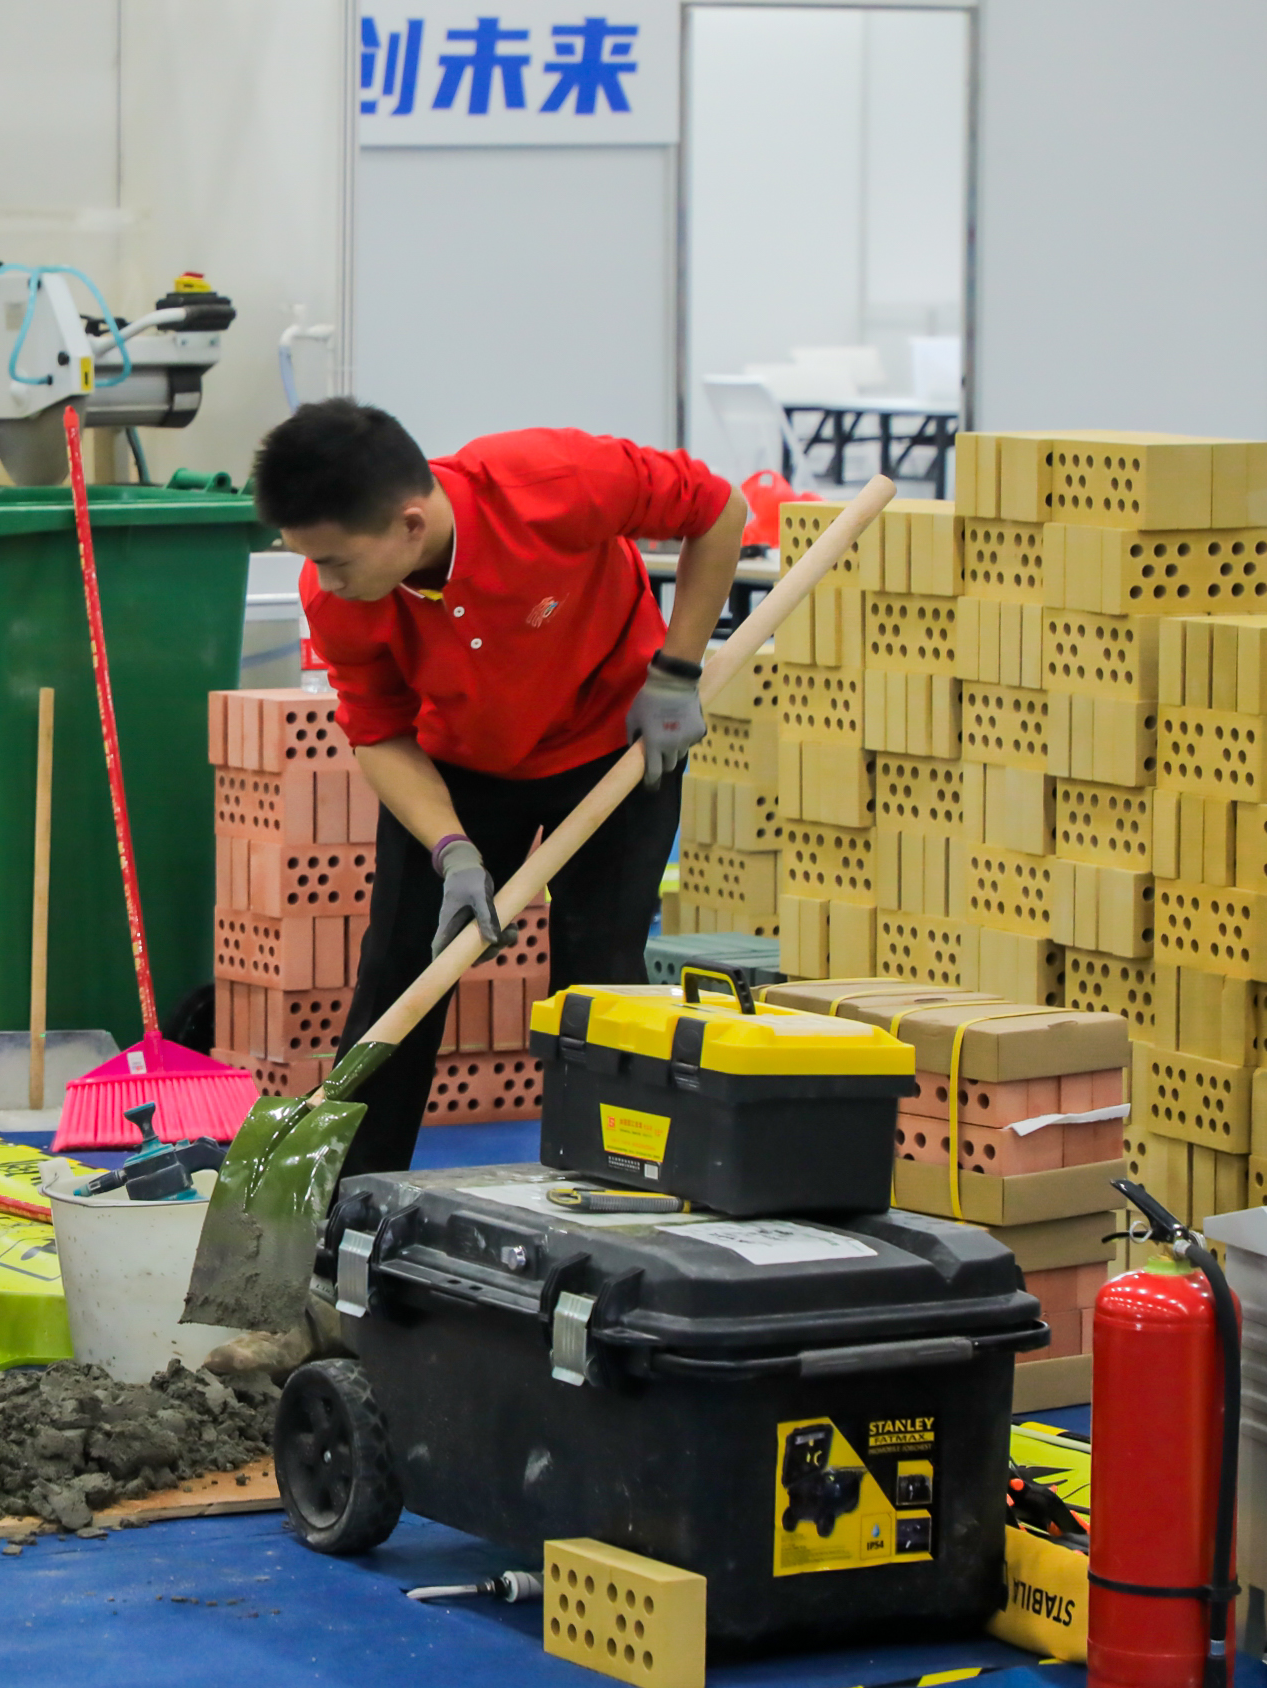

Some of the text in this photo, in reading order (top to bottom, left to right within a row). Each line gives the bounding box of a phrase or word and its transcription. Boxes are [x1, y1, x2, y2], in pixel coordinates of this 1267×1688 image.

[360, 17, 640, 116] 创未来
[869, 1417, 935, 1435] STANLEY
[874, 1433, 926, 1445] FATMAX
[866, 1540, 884, 1551] IP54
[1013, 1577, 1076, 1627] STABILA
